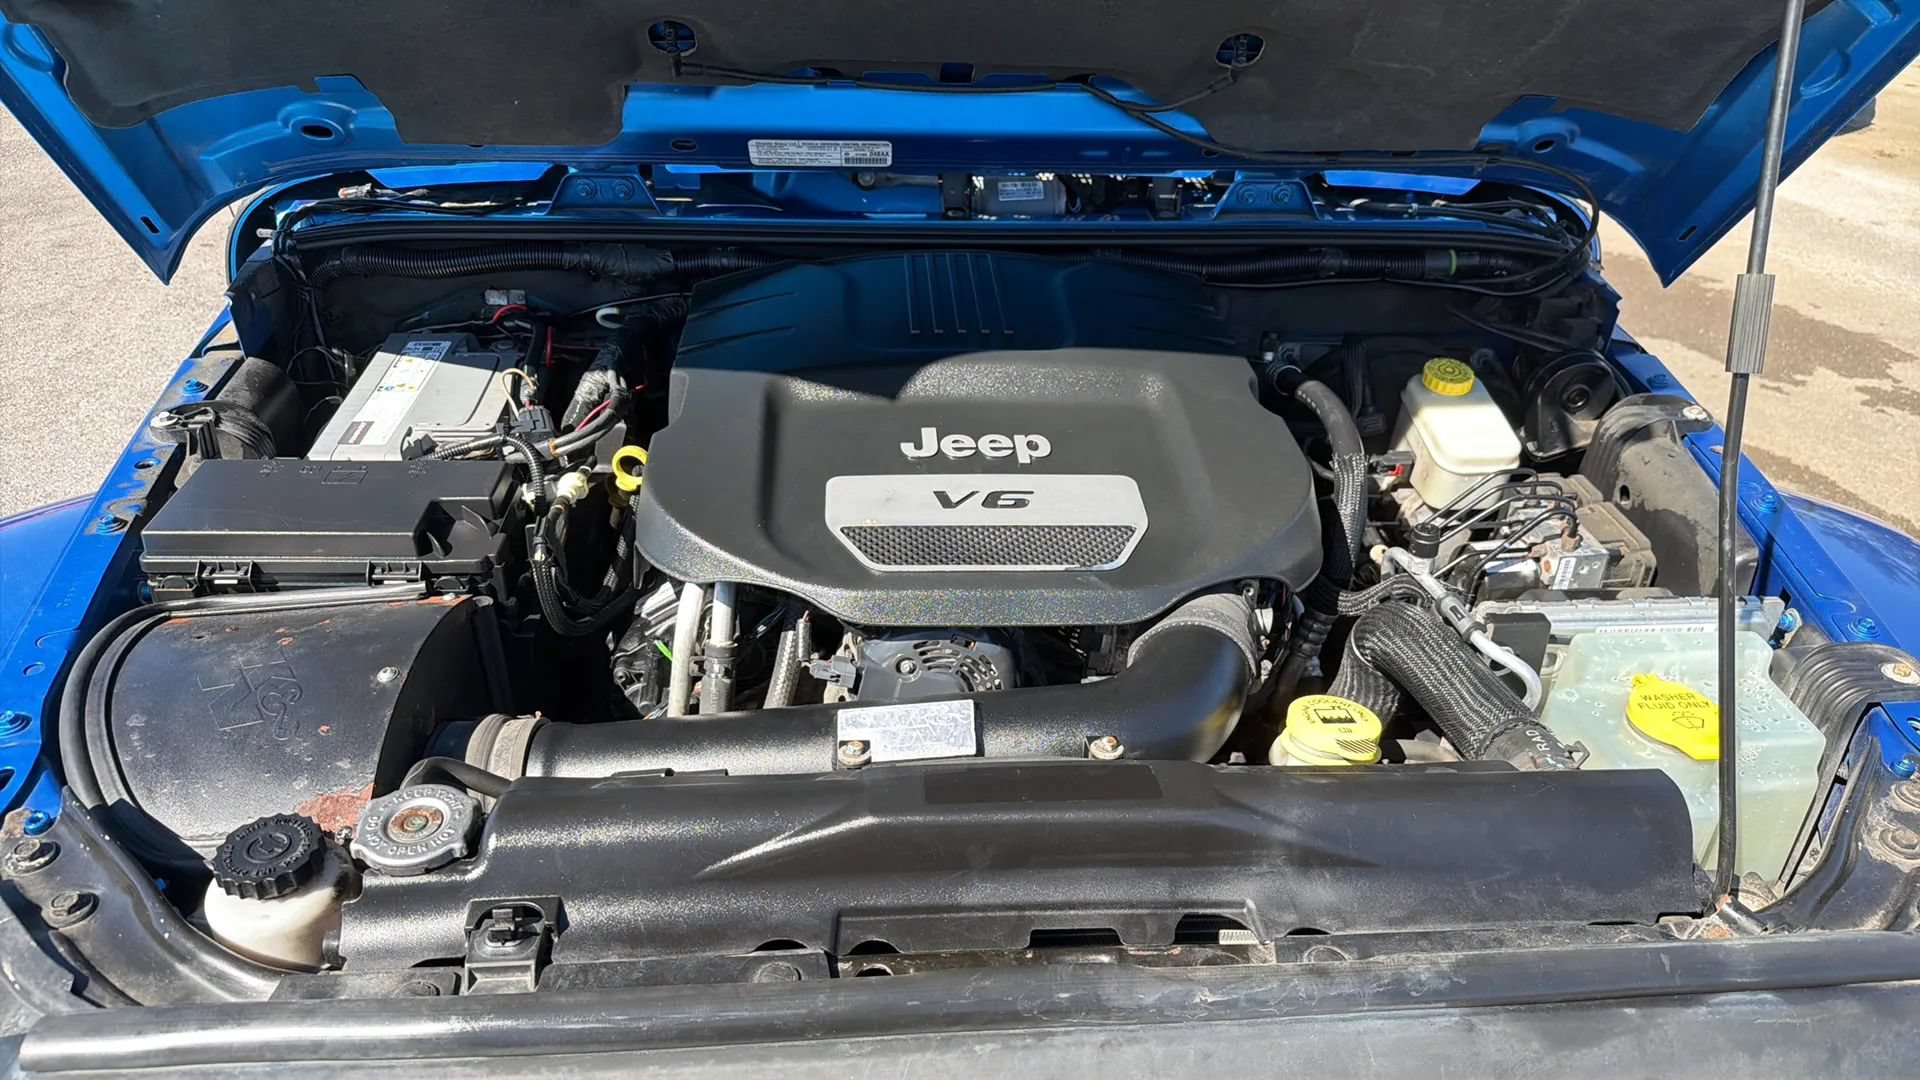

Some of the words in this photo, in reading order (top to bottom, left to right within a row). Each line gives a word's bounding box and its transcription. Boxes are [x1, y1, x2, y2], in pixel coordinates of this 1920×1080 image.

[899, 427, 1052, 463] Jeep
[932, 489, 1036, 509] V6
[1636, 702, 1676, 710] FLUID
[1677, 700, 1712, 709] ONLY
[1639, 692, 1697, 701] WASHER
[1525, 729, 1550, 752] RAD
[392, 787, 434, 804] KEEP
[365, 815, 381, 831] DO
[387, 845, 429, 856] OPEN
[430, 827, 457, 848] HOT
